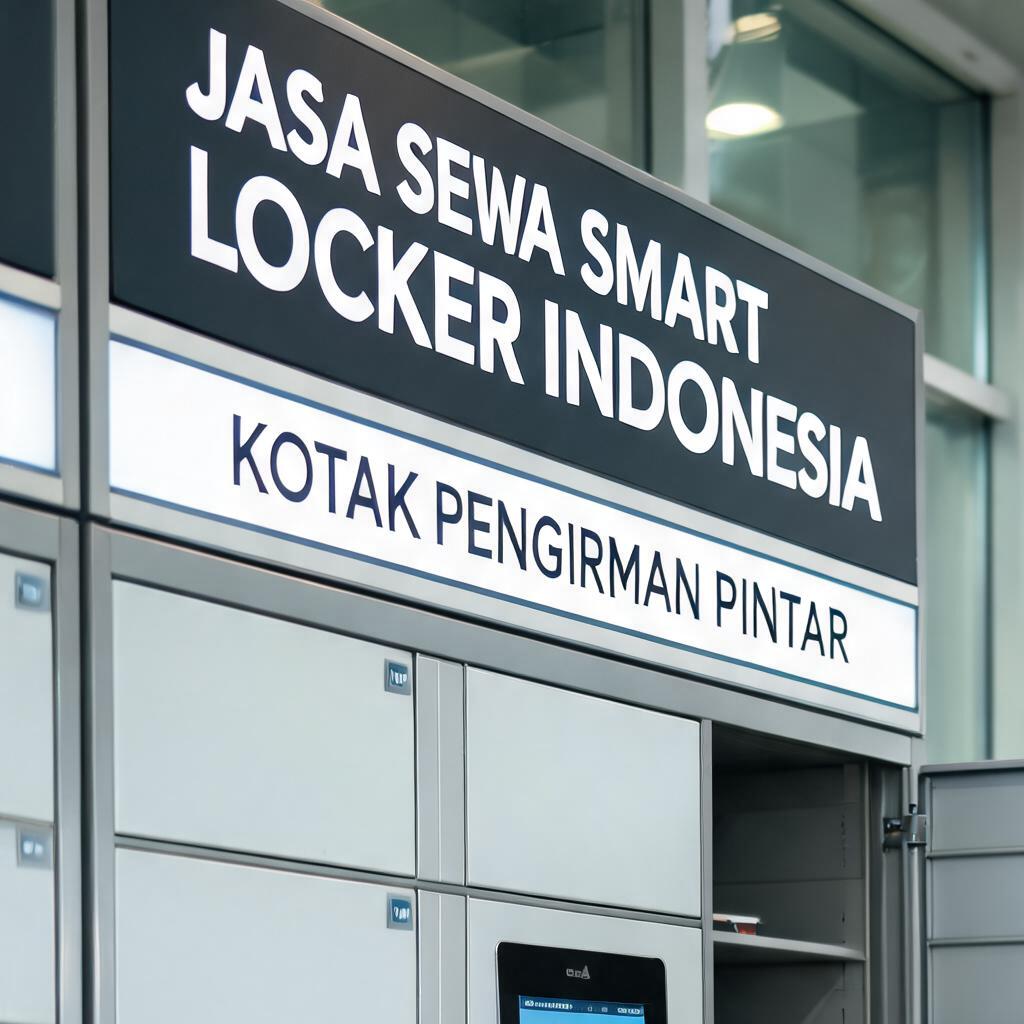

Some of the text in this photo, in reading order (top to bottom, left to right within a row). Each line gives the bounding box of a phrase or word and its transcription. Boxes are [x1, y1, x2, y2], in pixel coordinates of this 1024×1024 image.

[185, 28, 769, 364] JASA SEWA SMART
[190, 146, 883, 522] LOCKER INDONESIA
[232, 413, 849, 664] KOTAK PENGIRMAN PINTAR
